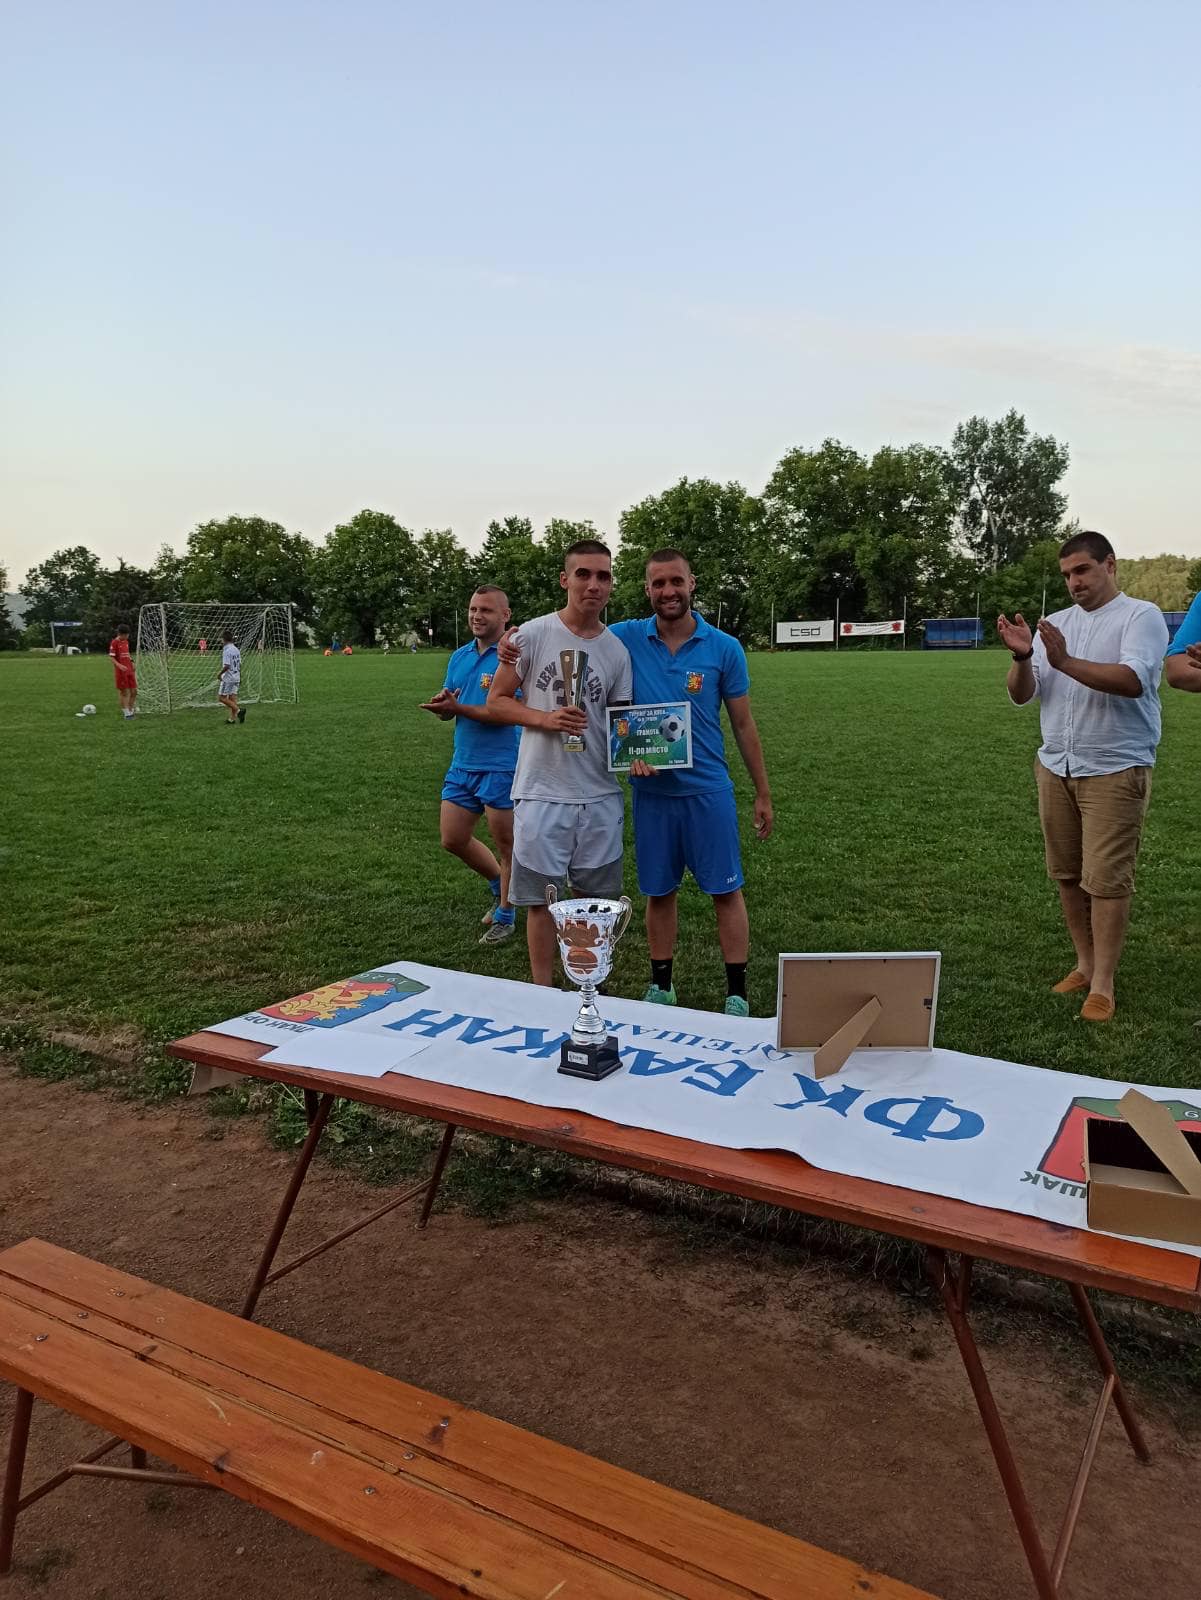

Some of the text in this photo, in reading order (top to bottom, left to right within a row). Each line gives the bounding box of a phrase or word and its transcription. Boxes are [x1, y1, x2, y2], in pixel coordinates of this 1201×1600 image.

[536, 661, 557, 692] NEW
[240, 1015, 269, 1025] ОР
[382, 1008, 984, 1142] ФК БАКАН
